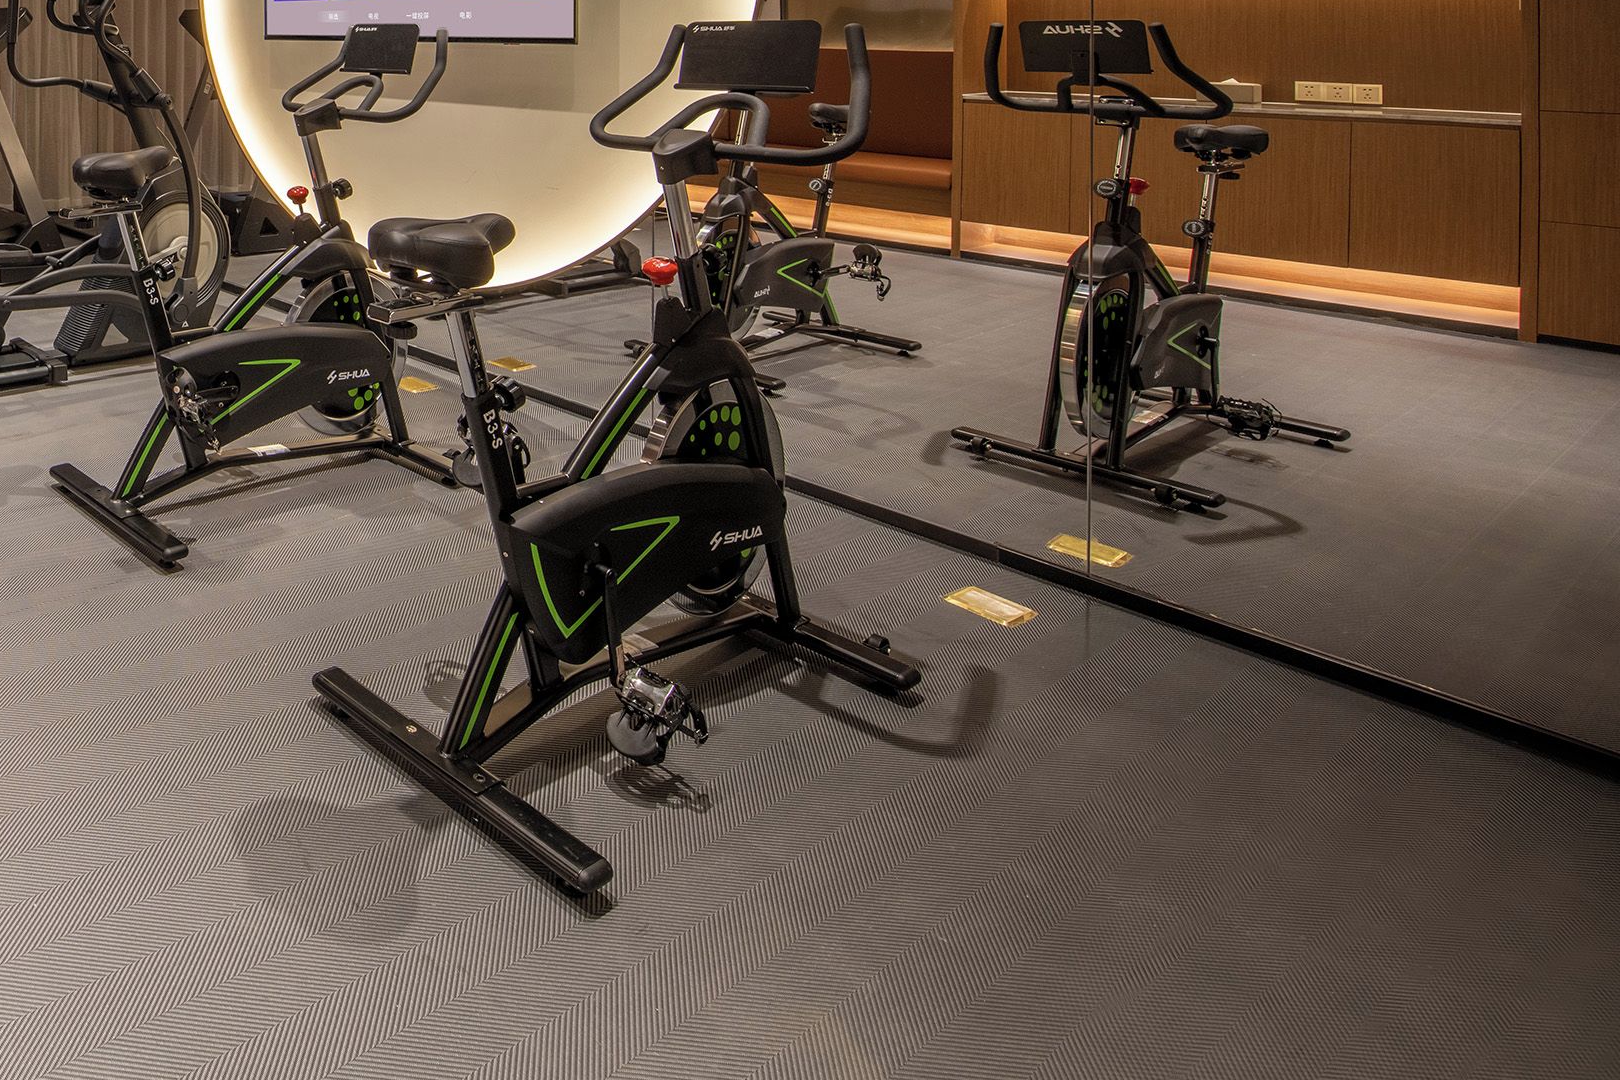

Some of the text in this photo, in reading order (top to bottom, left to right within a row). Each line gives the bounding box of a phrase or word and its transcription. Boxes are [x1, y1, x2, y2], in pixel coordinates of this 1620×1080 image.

[143, 278, 159, 305] B3-S
[337, 368, 371, 381] SHUA
[483, 408, 503, 450] B3-S
[723, 525, 763, 545] SHUA
